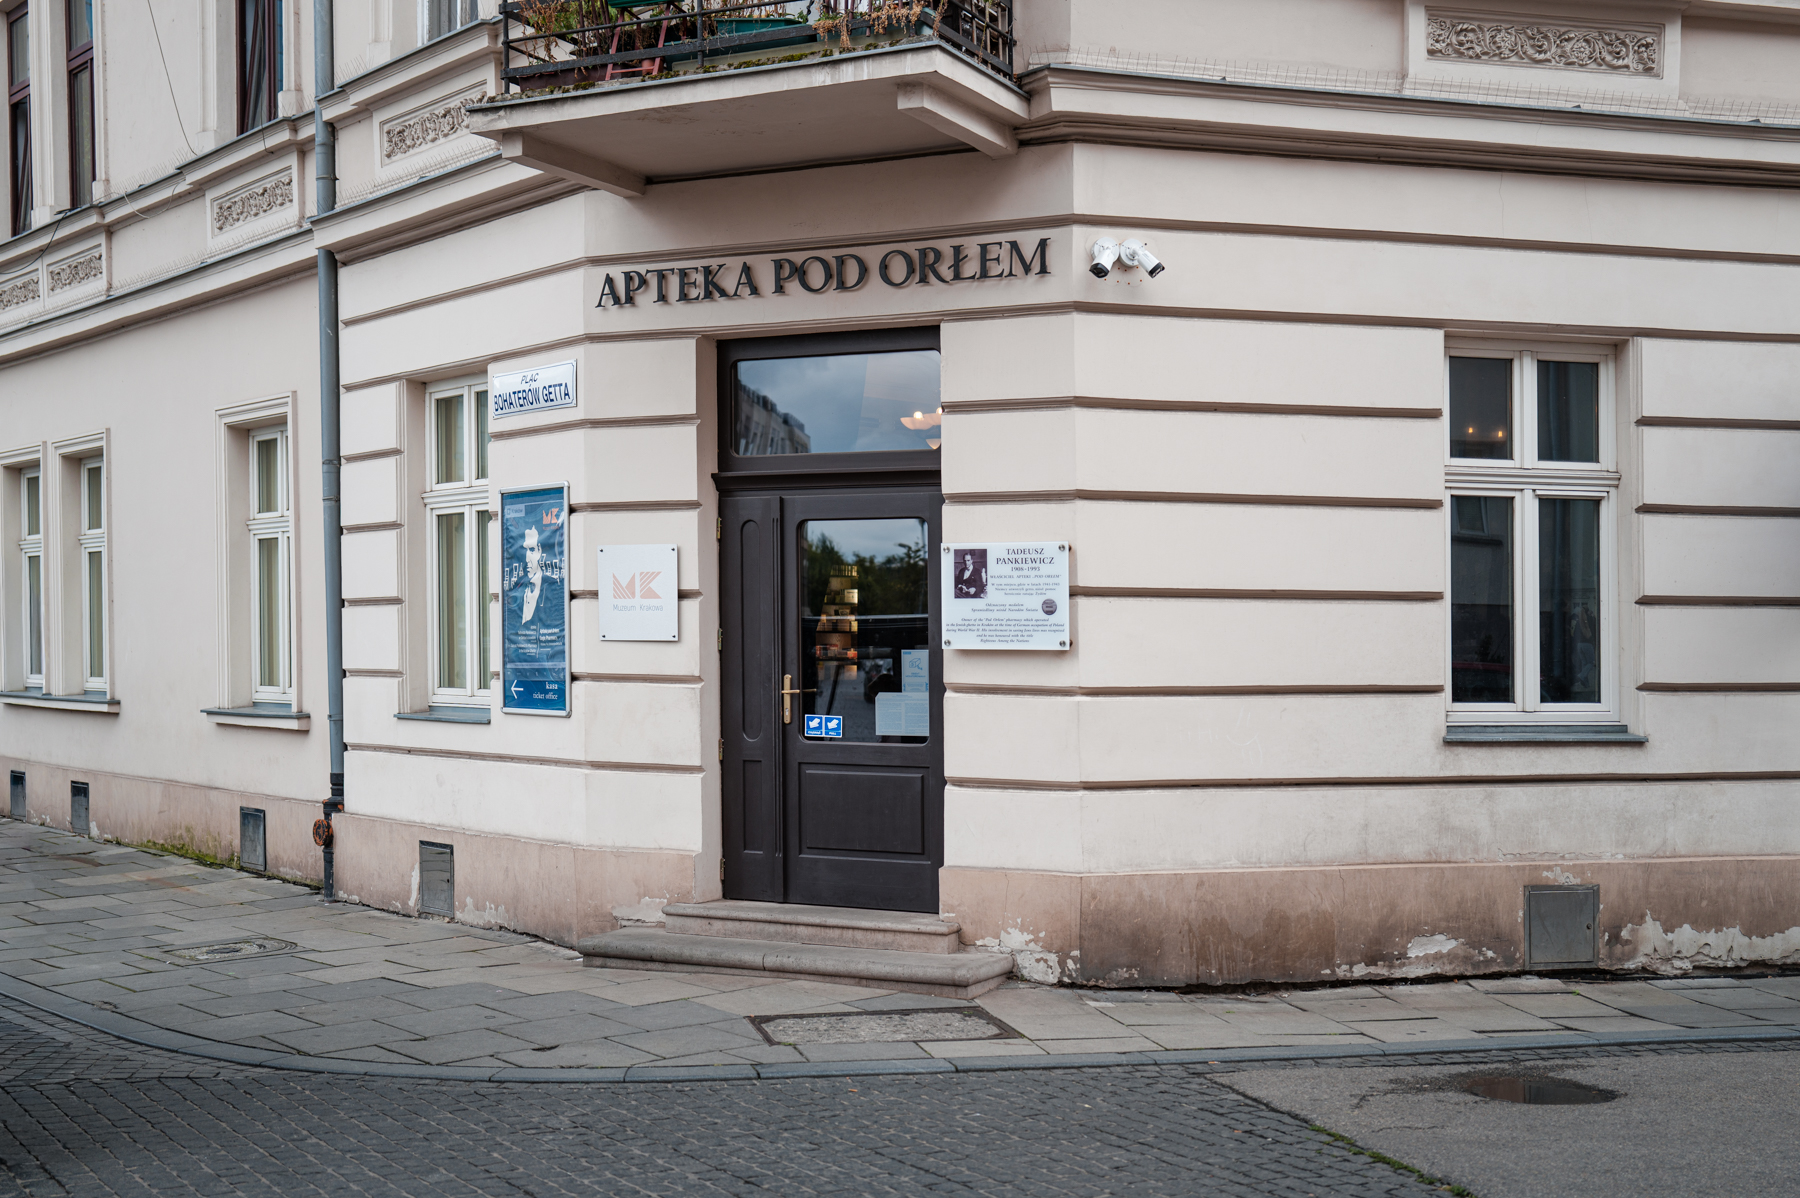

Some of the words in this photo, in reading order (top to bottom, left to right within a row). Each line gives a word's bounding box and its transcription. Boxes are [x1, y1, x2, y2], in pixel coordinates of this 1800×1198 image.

[594, 261, 758, 309] APTEKA
[770, 253, 869, 295] POD
[878, 237, 1052, 288] ORŁEM
[520, 372, 540, 385] PLAC
[494, 384, 540, 412] BOHATERÓW
[542, 382, 570, 403] GETTA
[996, 556, 1055, 565] PANKIEWICZ
[612, 571, 662, 600] MK
[640, 604, 664, 612] Krakowa
[546, 682, 558, 690] kasa
[545, 692, 558, 700] office
